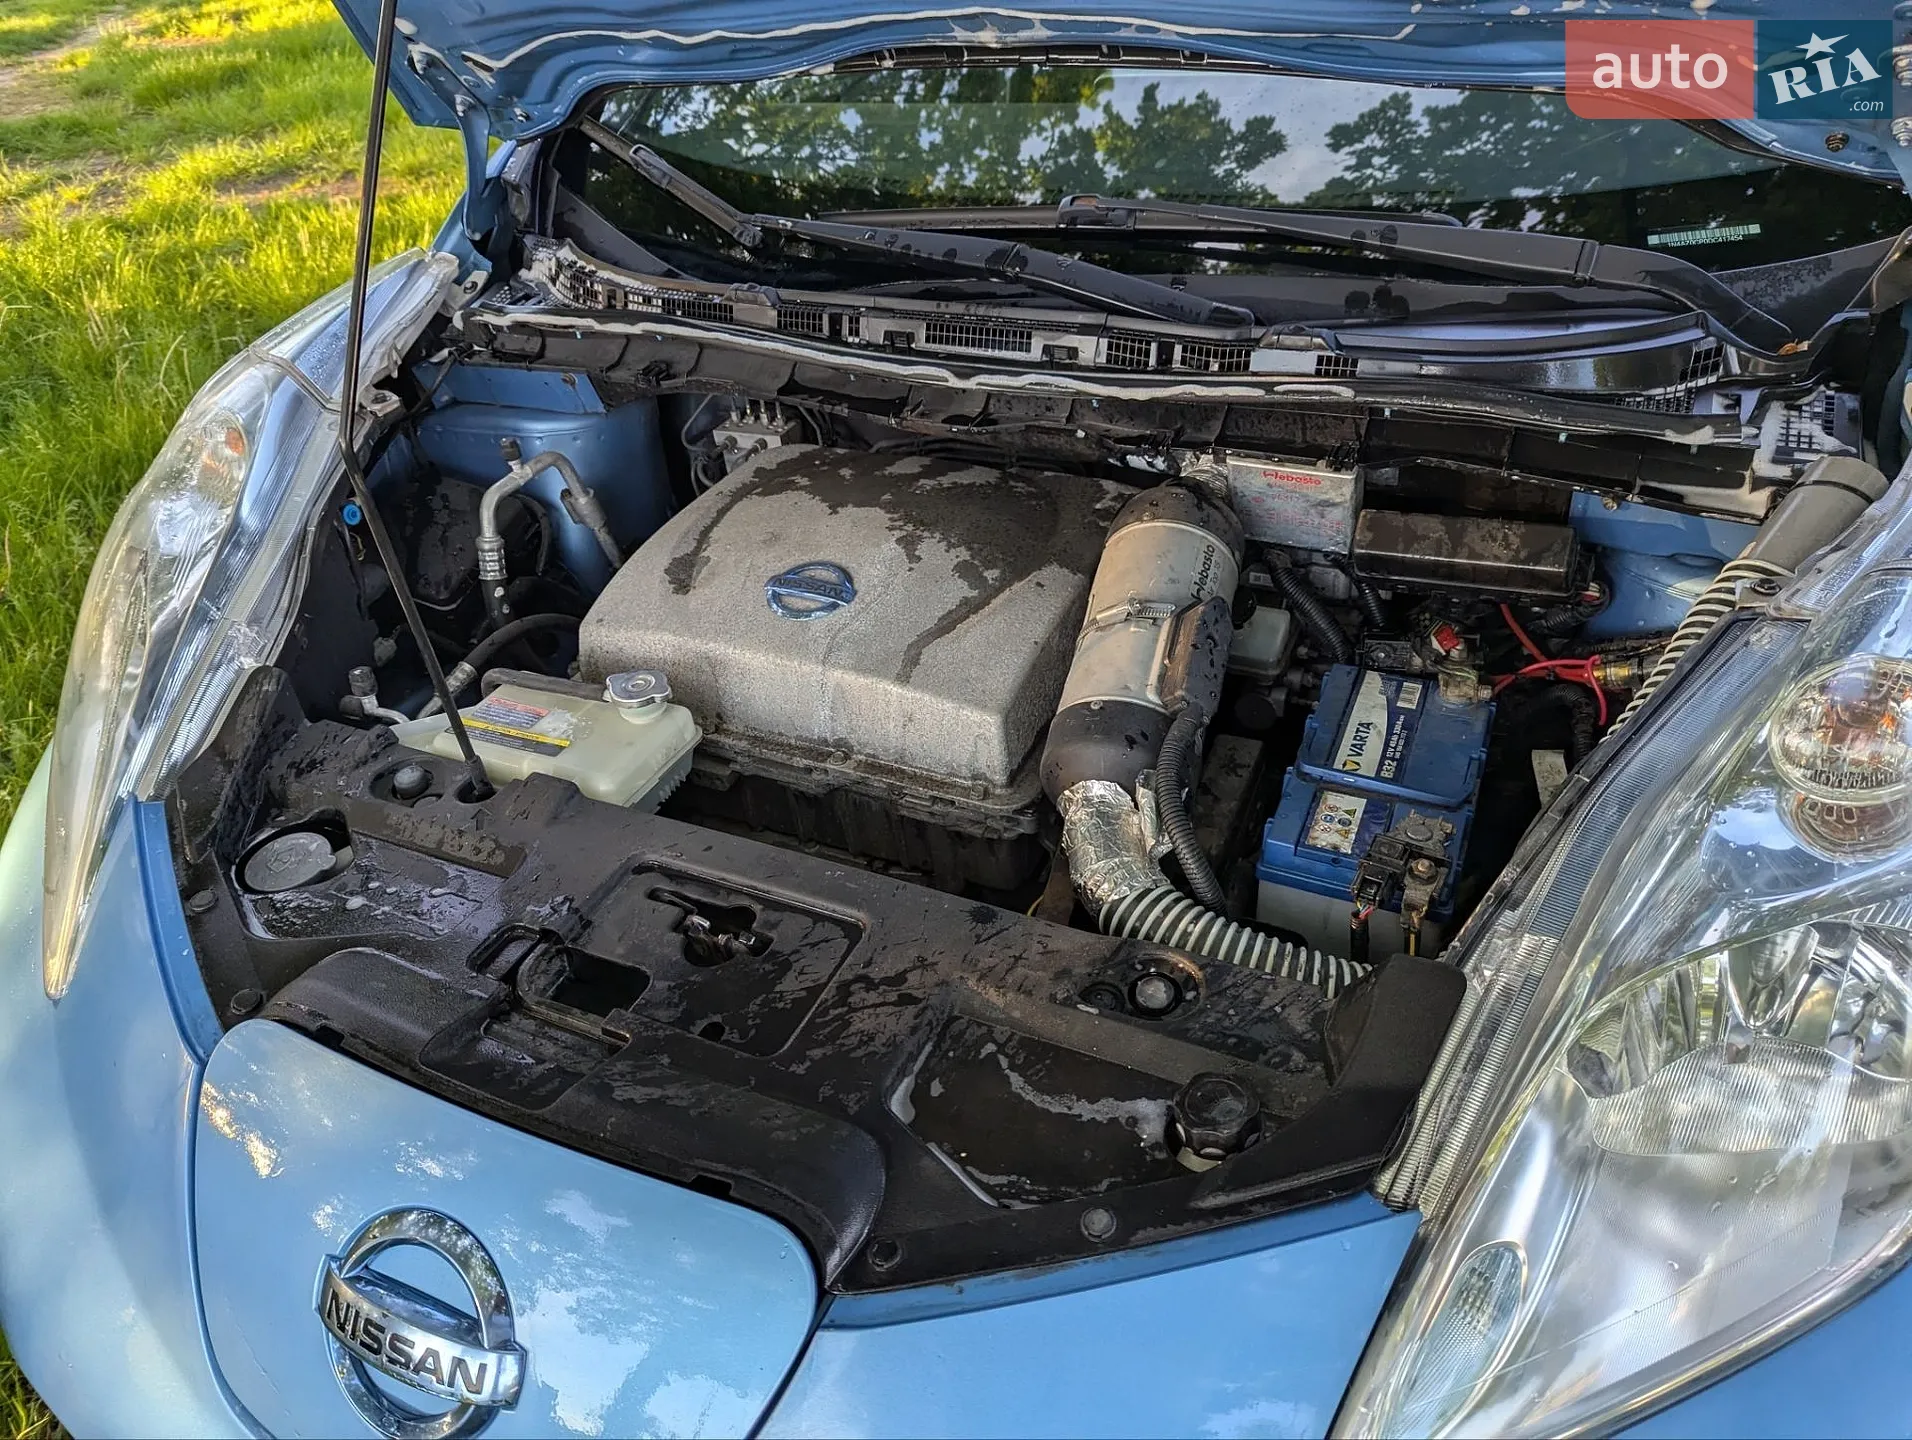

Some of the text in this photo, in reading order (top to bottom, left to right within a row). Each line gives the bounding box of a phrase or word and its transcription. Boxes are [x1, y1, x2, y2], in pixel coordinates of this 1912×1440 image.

[1261, 470, 1323, 486] Webasto
[1190, 544, 1215, 600] Webasto
[773, 577, 844, 599] NISSAN
[1347, 721, 1373, 757] VARTA
[1380, 760, 1397, 778] B32
[326, 1287, 488, 1395] NISSAN
